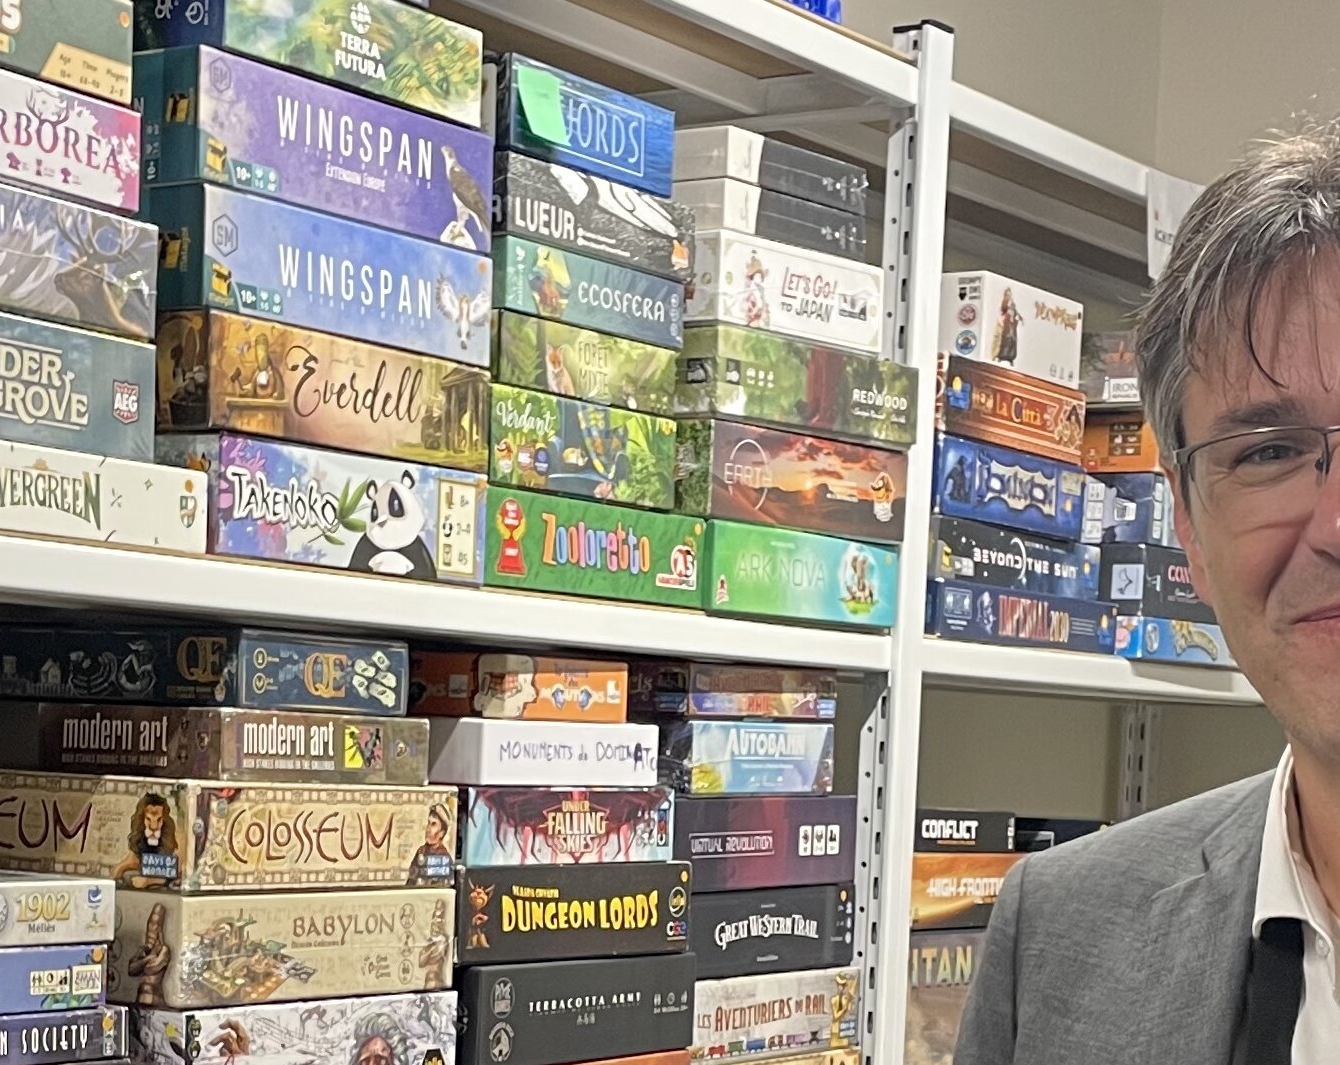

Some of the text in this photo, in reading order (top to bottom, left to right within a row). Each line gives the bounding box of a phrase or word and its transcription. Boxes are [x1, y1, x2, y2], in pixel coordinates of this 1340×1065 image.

[340, 32, 381, 61] TERRA
[335, 51, 387, 81] FUTURA
[277, 95, 432, 181] WINGSPAN
[515, 196, 576, 240] LUEUR
[279, 244, 433, 320] WINGSPAN
[781, 266, 838, 300] LET'S GO!
[578, 282, 665, 322] ECOSFERA
[780, 301, 793, 313] TO
[795, 299, 833, 323] JAPAN
[286, 345, 425, 424] Everdell
[852, 384, 907, 410] REDWOOD
[113, 391, 139, 415] AEG
[496, 401, 556, 434] Verdant
[996, 398, 1007, 417] La
[724, 463, 772, 485] EARTH
[229, 468, 340, 529] TAKENOKO
[542, 513, 651, 574] Zooloretto
[974, 547, 1024, 570] BEYOND
[736, 553, 826, 587] ARK NOVA
[177, 636, 228, 685] QE
[304, 652, 349, 700] QE
[63, 711, 170, 752] modern art
[243, 717, 335, 756] modern art
[728, 728, 806, 758] AUTOBAHN
[499, 740, 573, 762] MONUMENTS
[227, 808, 395, 865] COLOSSEUM
[547, 811, 607, 836] FALLING
[922, 819, 979, 840] CONFLICT
[557, 833, 595, 854] SKIES
[16, 892, 71, 922] 1902
[502, 889, 658, 933] DUNGEON LORDS
[291, 914, 397, 946] BABYLON
[715, 914, 819, 950] GREAT TRAIL
[528, 991, 642, 1013] TERRACOTTA ARMY
[698, 995, 829, 1033] LES AVENTURIERS RAIL
[21, 1024, 89, 1054] SOCIETY
